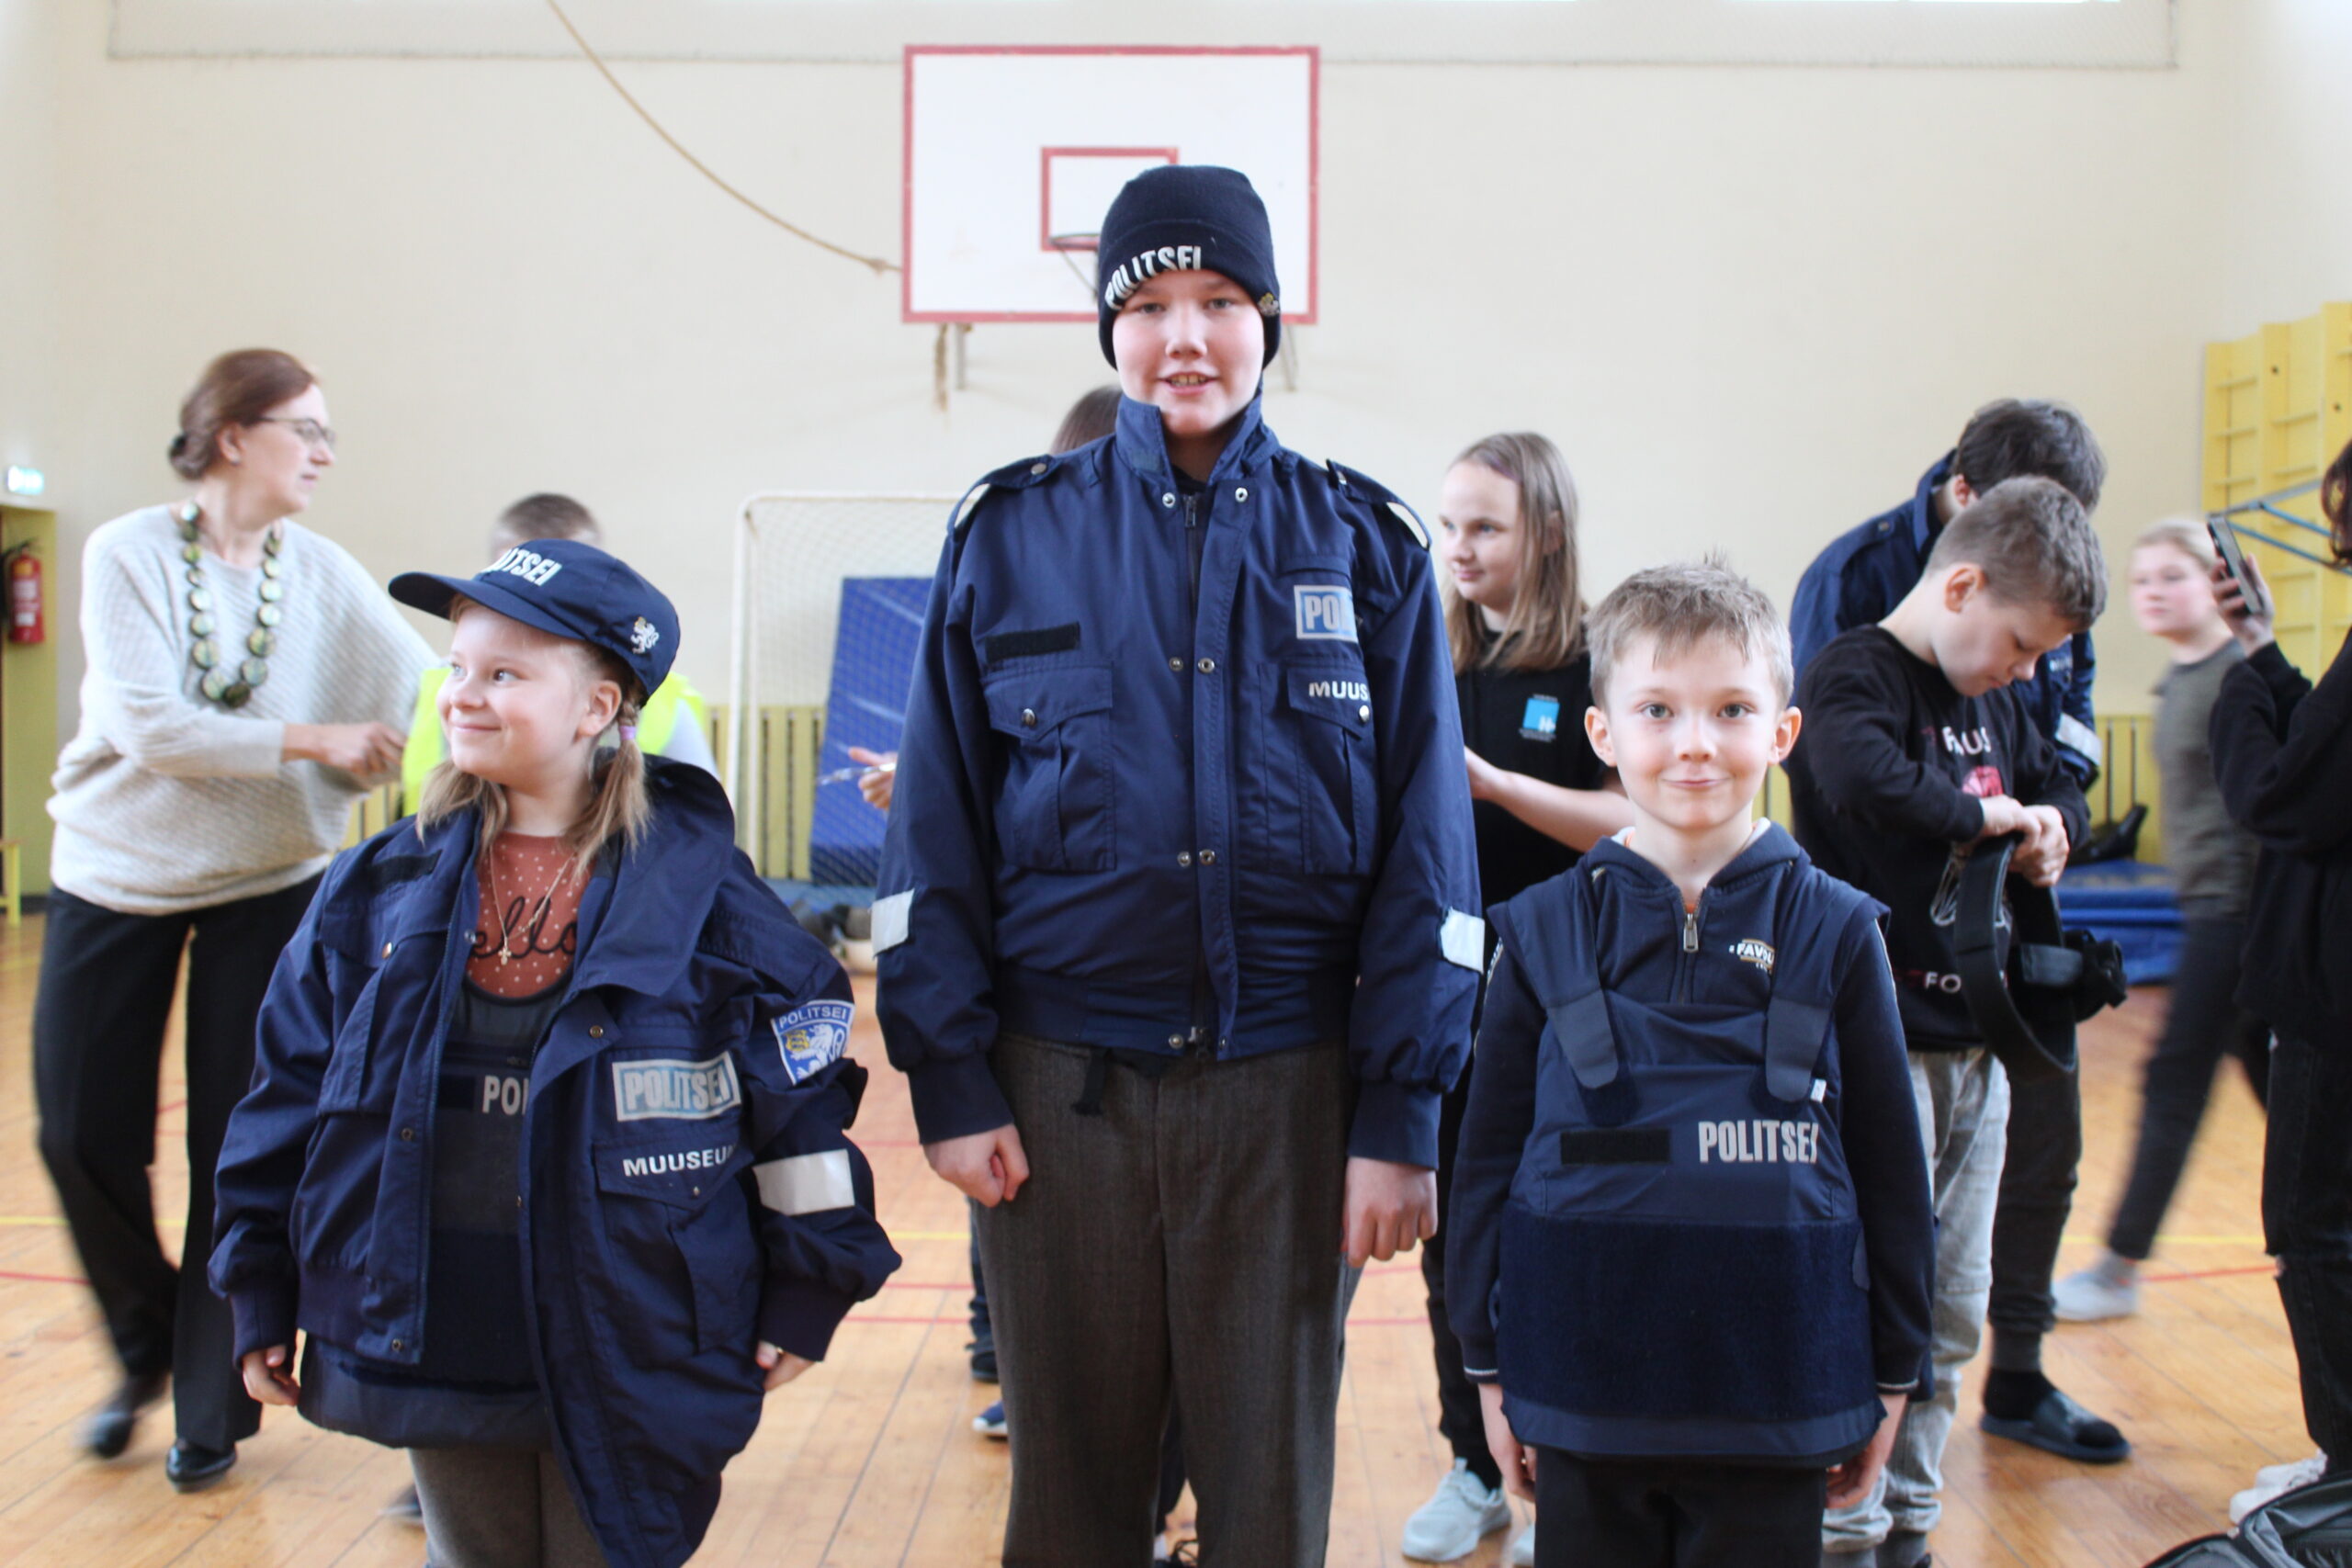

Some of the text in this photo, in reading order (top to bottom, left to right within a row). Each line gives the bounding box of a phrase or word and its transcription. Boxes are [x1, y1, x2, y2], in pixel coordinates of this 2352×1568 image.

[1309, 681, 1369, 702] MUUS
[779, 1006, 848, 1029] POLITSEI
[624, 1063, 732, 1111] POLITSEI
[1698, 1119, 1819, 1164] POLITSEI
